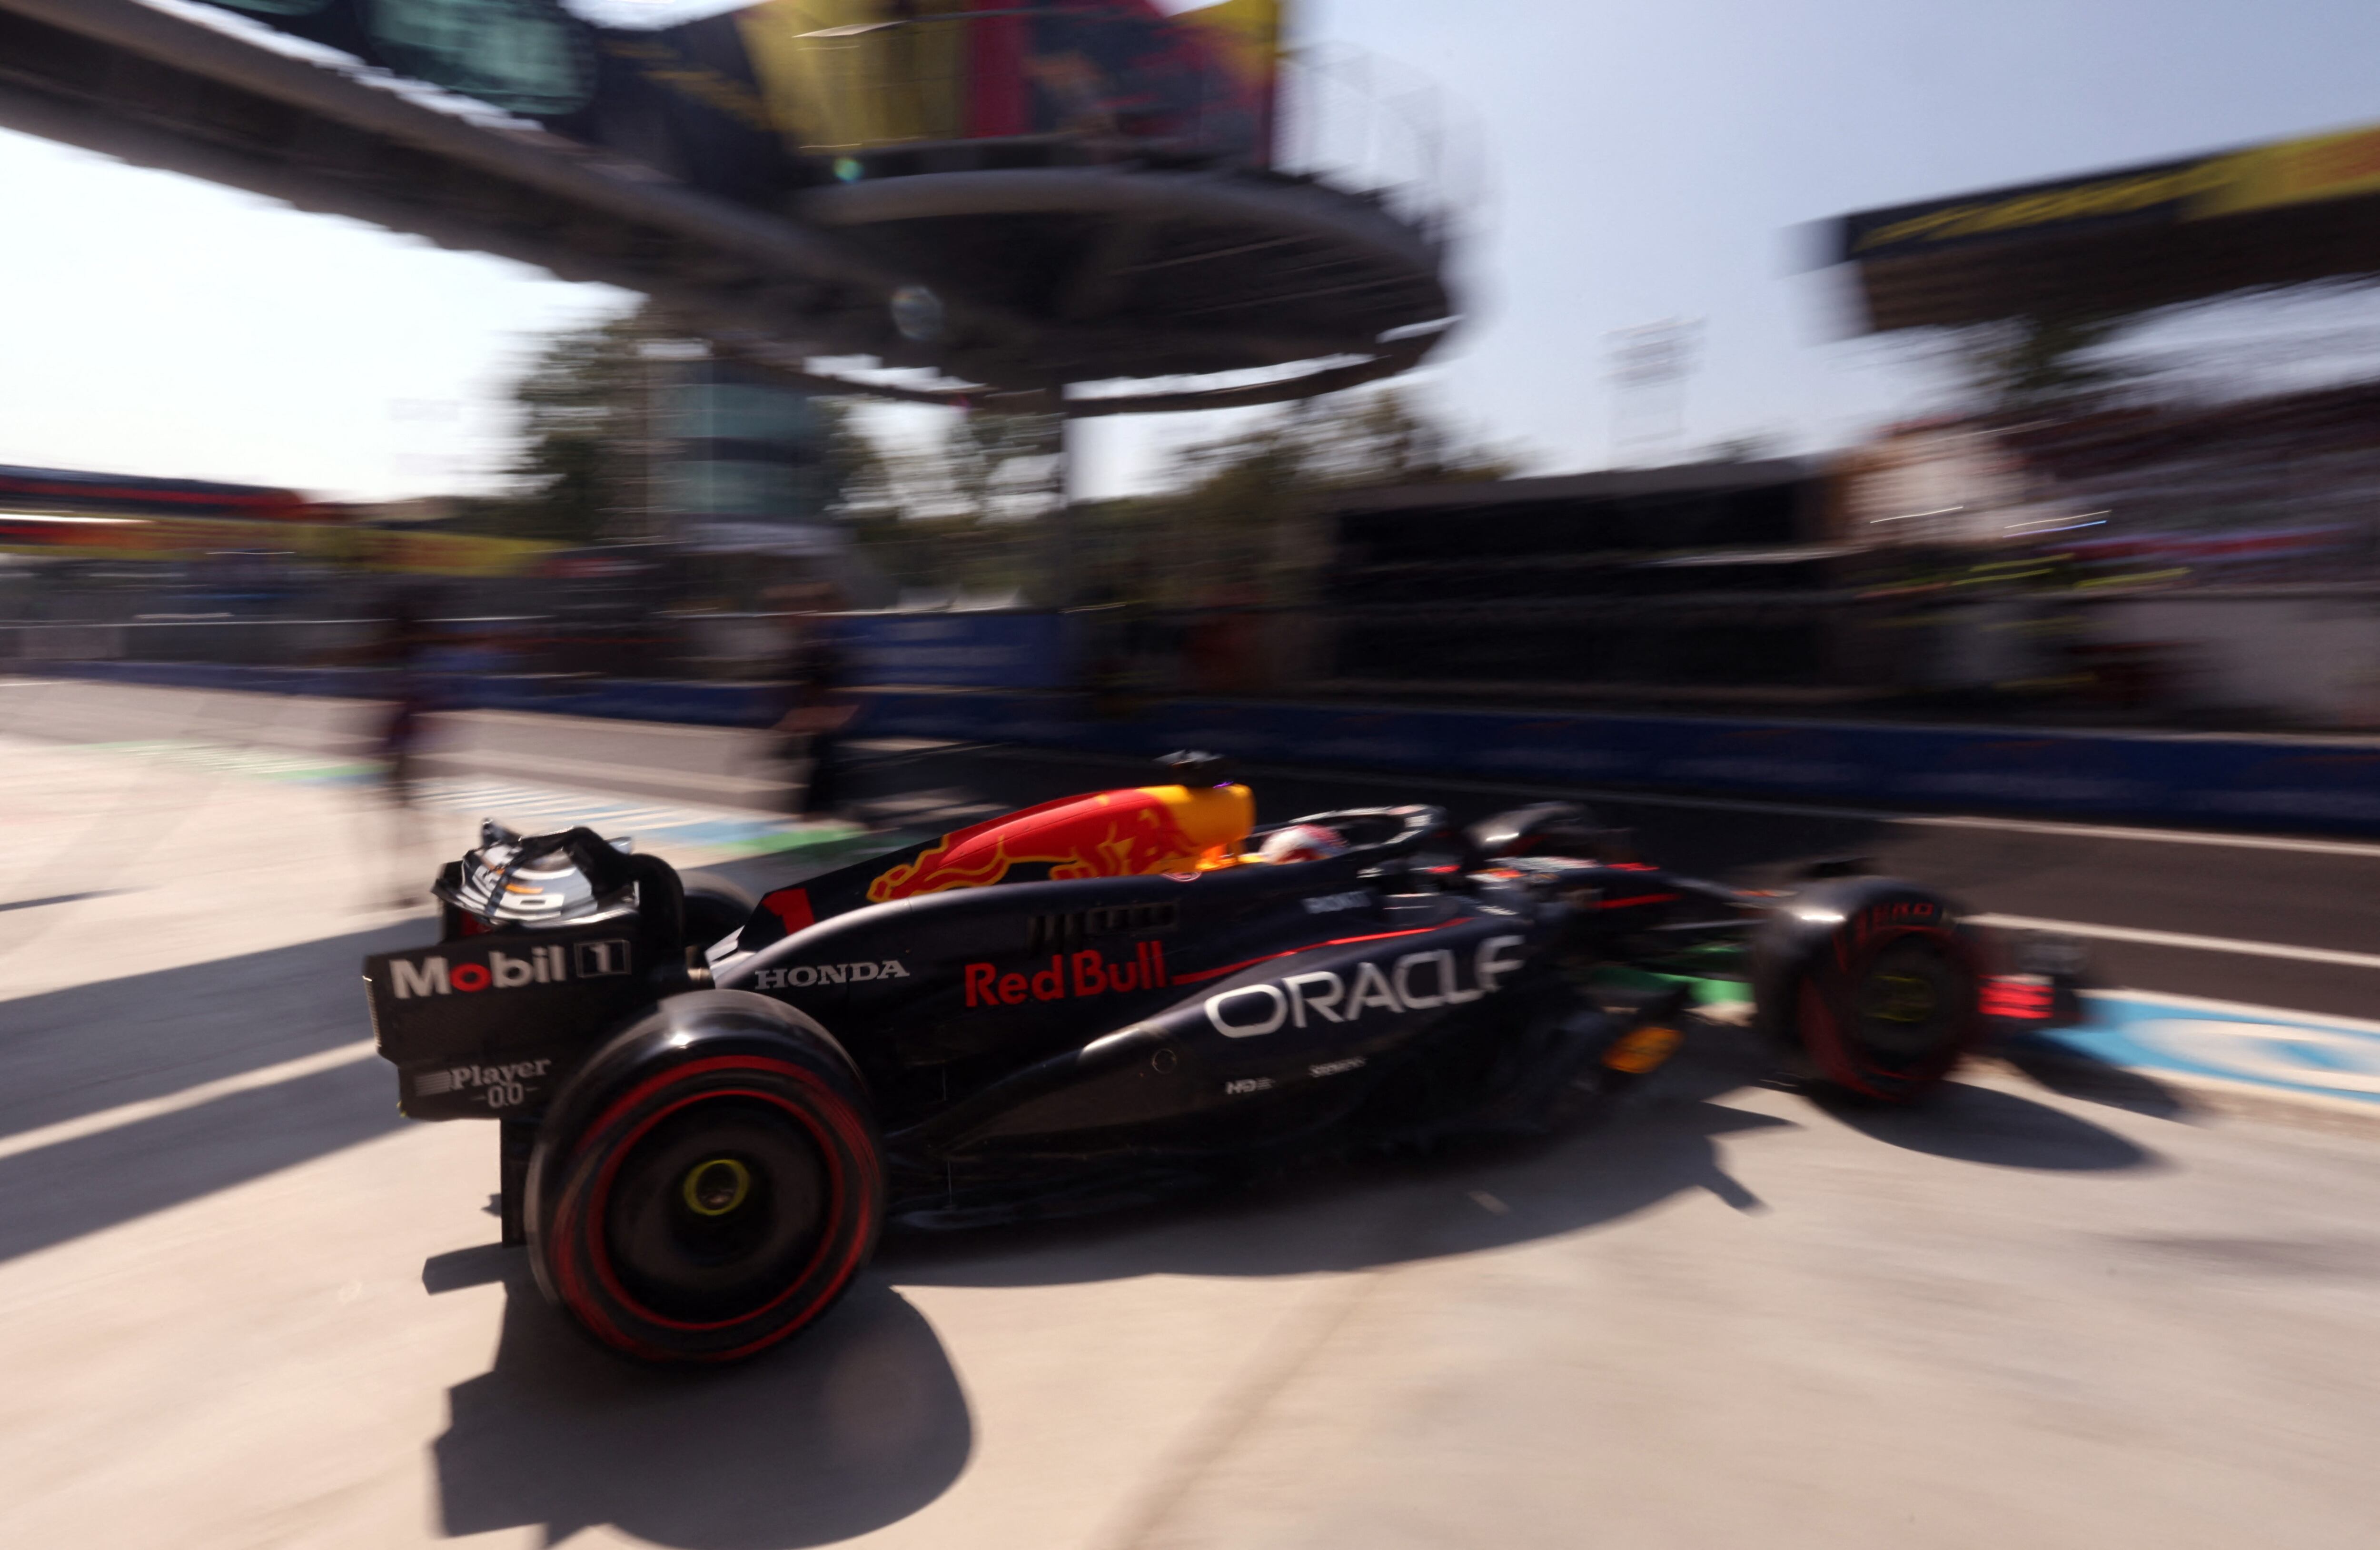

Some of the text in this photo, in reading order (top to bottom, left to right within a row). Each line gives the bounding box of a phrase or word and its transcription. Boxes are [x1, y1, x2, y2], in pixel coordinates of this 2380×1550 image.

[761, 888, 815, 935] 1
[389, 945, 566, 999] Mobil
[755, 960, 910, 990] HONDA
[965, 940, 1167, 1007] Red Bull
[1205, 935, 1526, 1038] ORACLE
[450, 1059, 551, 1091] Player
